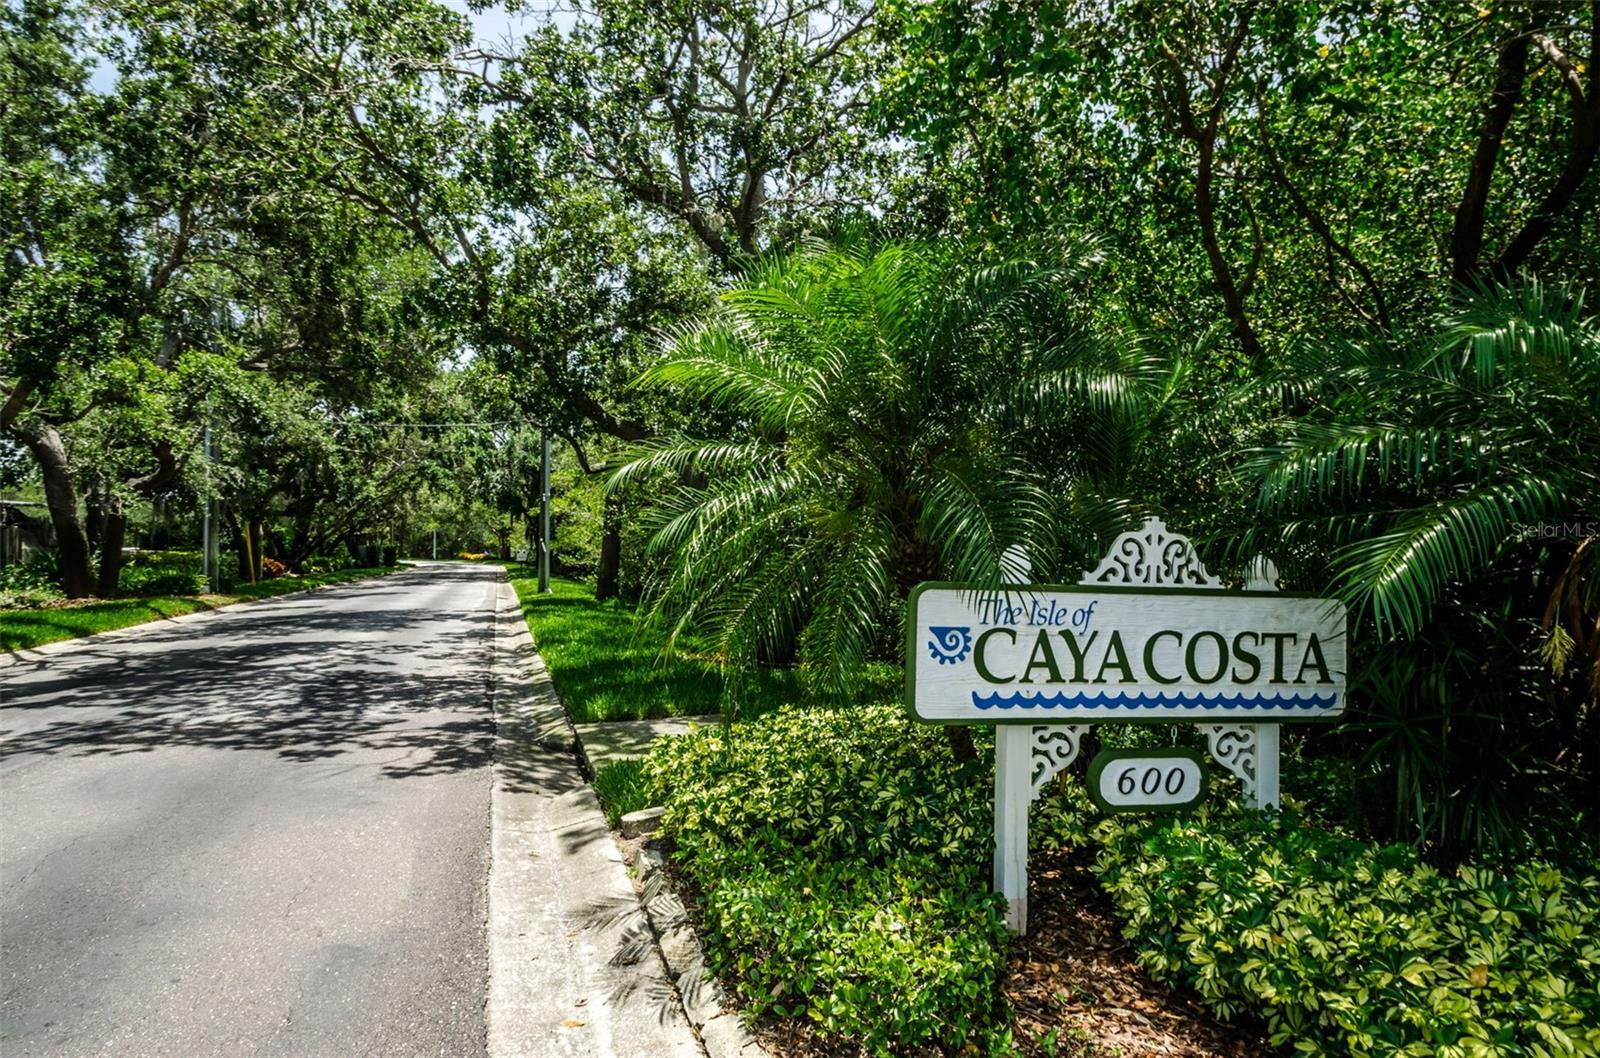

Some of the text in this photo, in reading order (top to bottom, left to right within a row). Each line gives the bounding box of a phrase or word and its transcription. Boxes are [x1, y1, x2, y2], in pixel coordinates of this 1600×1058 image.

[978, 598, 1098, 636] The Isle of
[1117, 767, 1186, 796] 600
